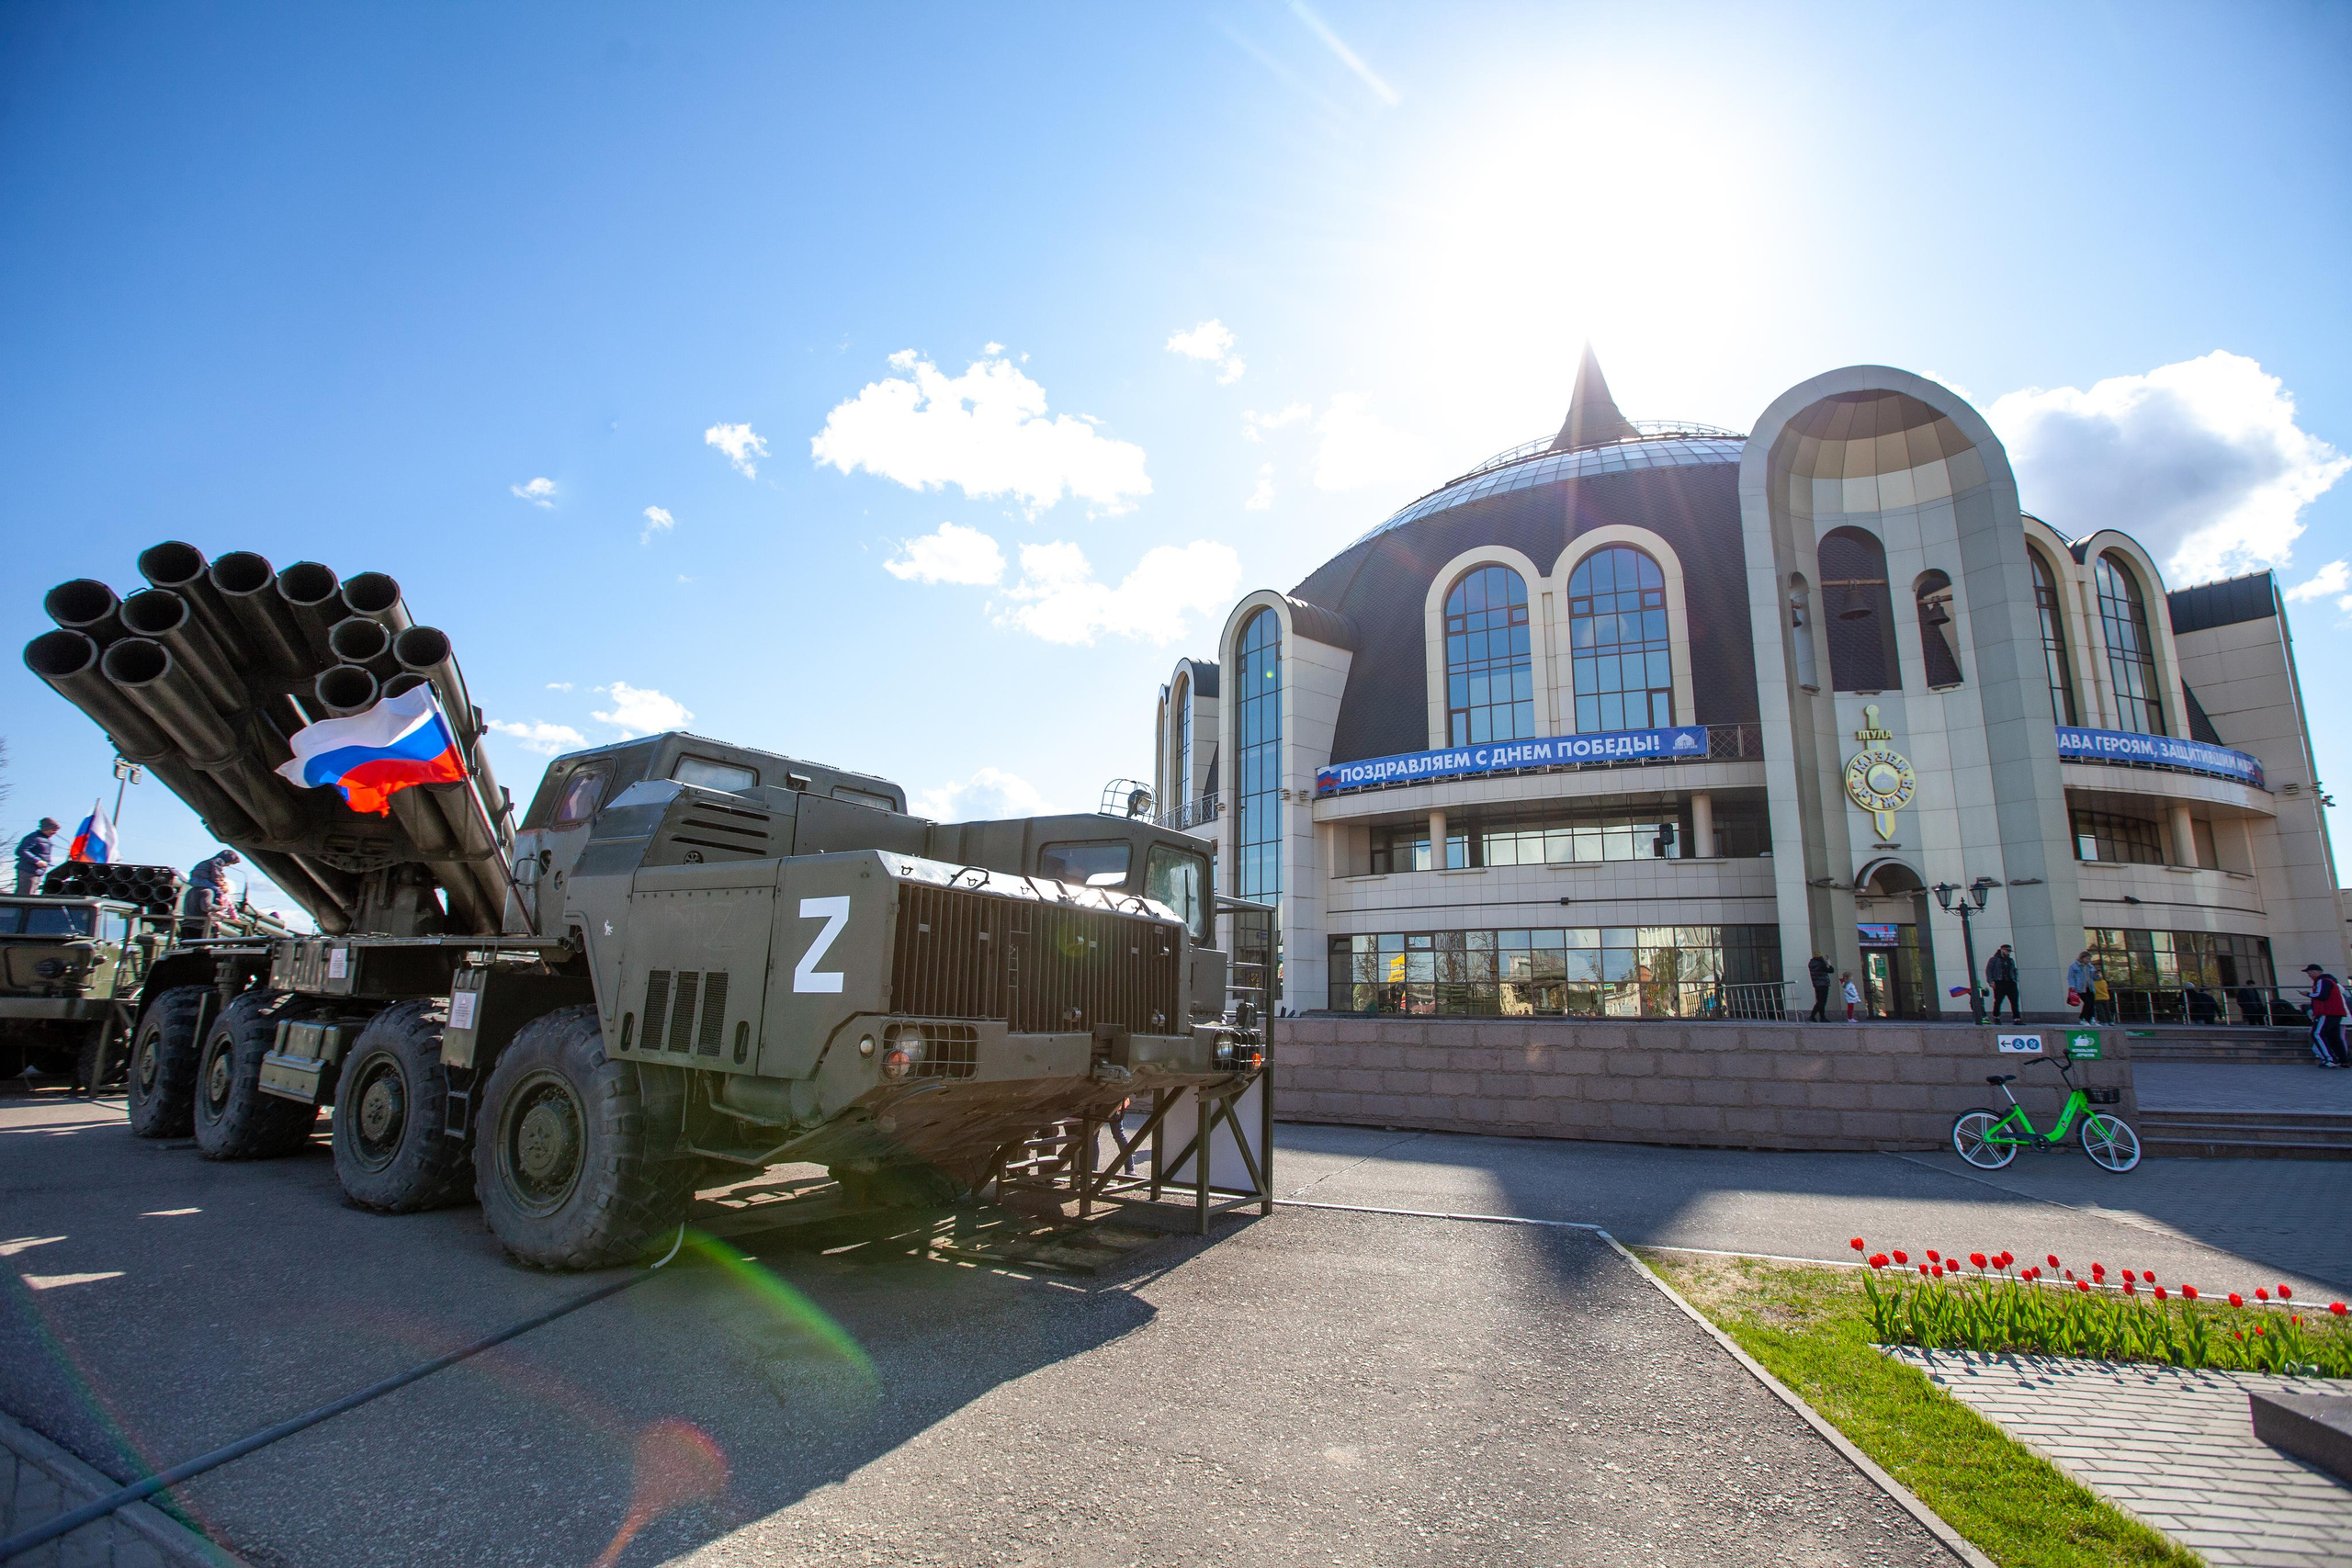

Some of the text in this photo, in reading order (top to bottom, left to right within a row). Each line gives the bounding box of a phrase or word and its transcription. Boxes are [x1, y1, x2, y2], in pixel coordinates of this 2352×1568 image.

[1857, 729, 1893, 740] ТУЛА
[2096, 736, 2158, 758] ГЕРОЯМ,
[2161, 742, 2237, 770] ЗАЩИТИВШИМ
[1340, 735, 1660, 783] ПОЗДРАВЛЯЕМ С ДНЕМ ПОБЕДЫ!
[793, 896, 850, 993] Z
